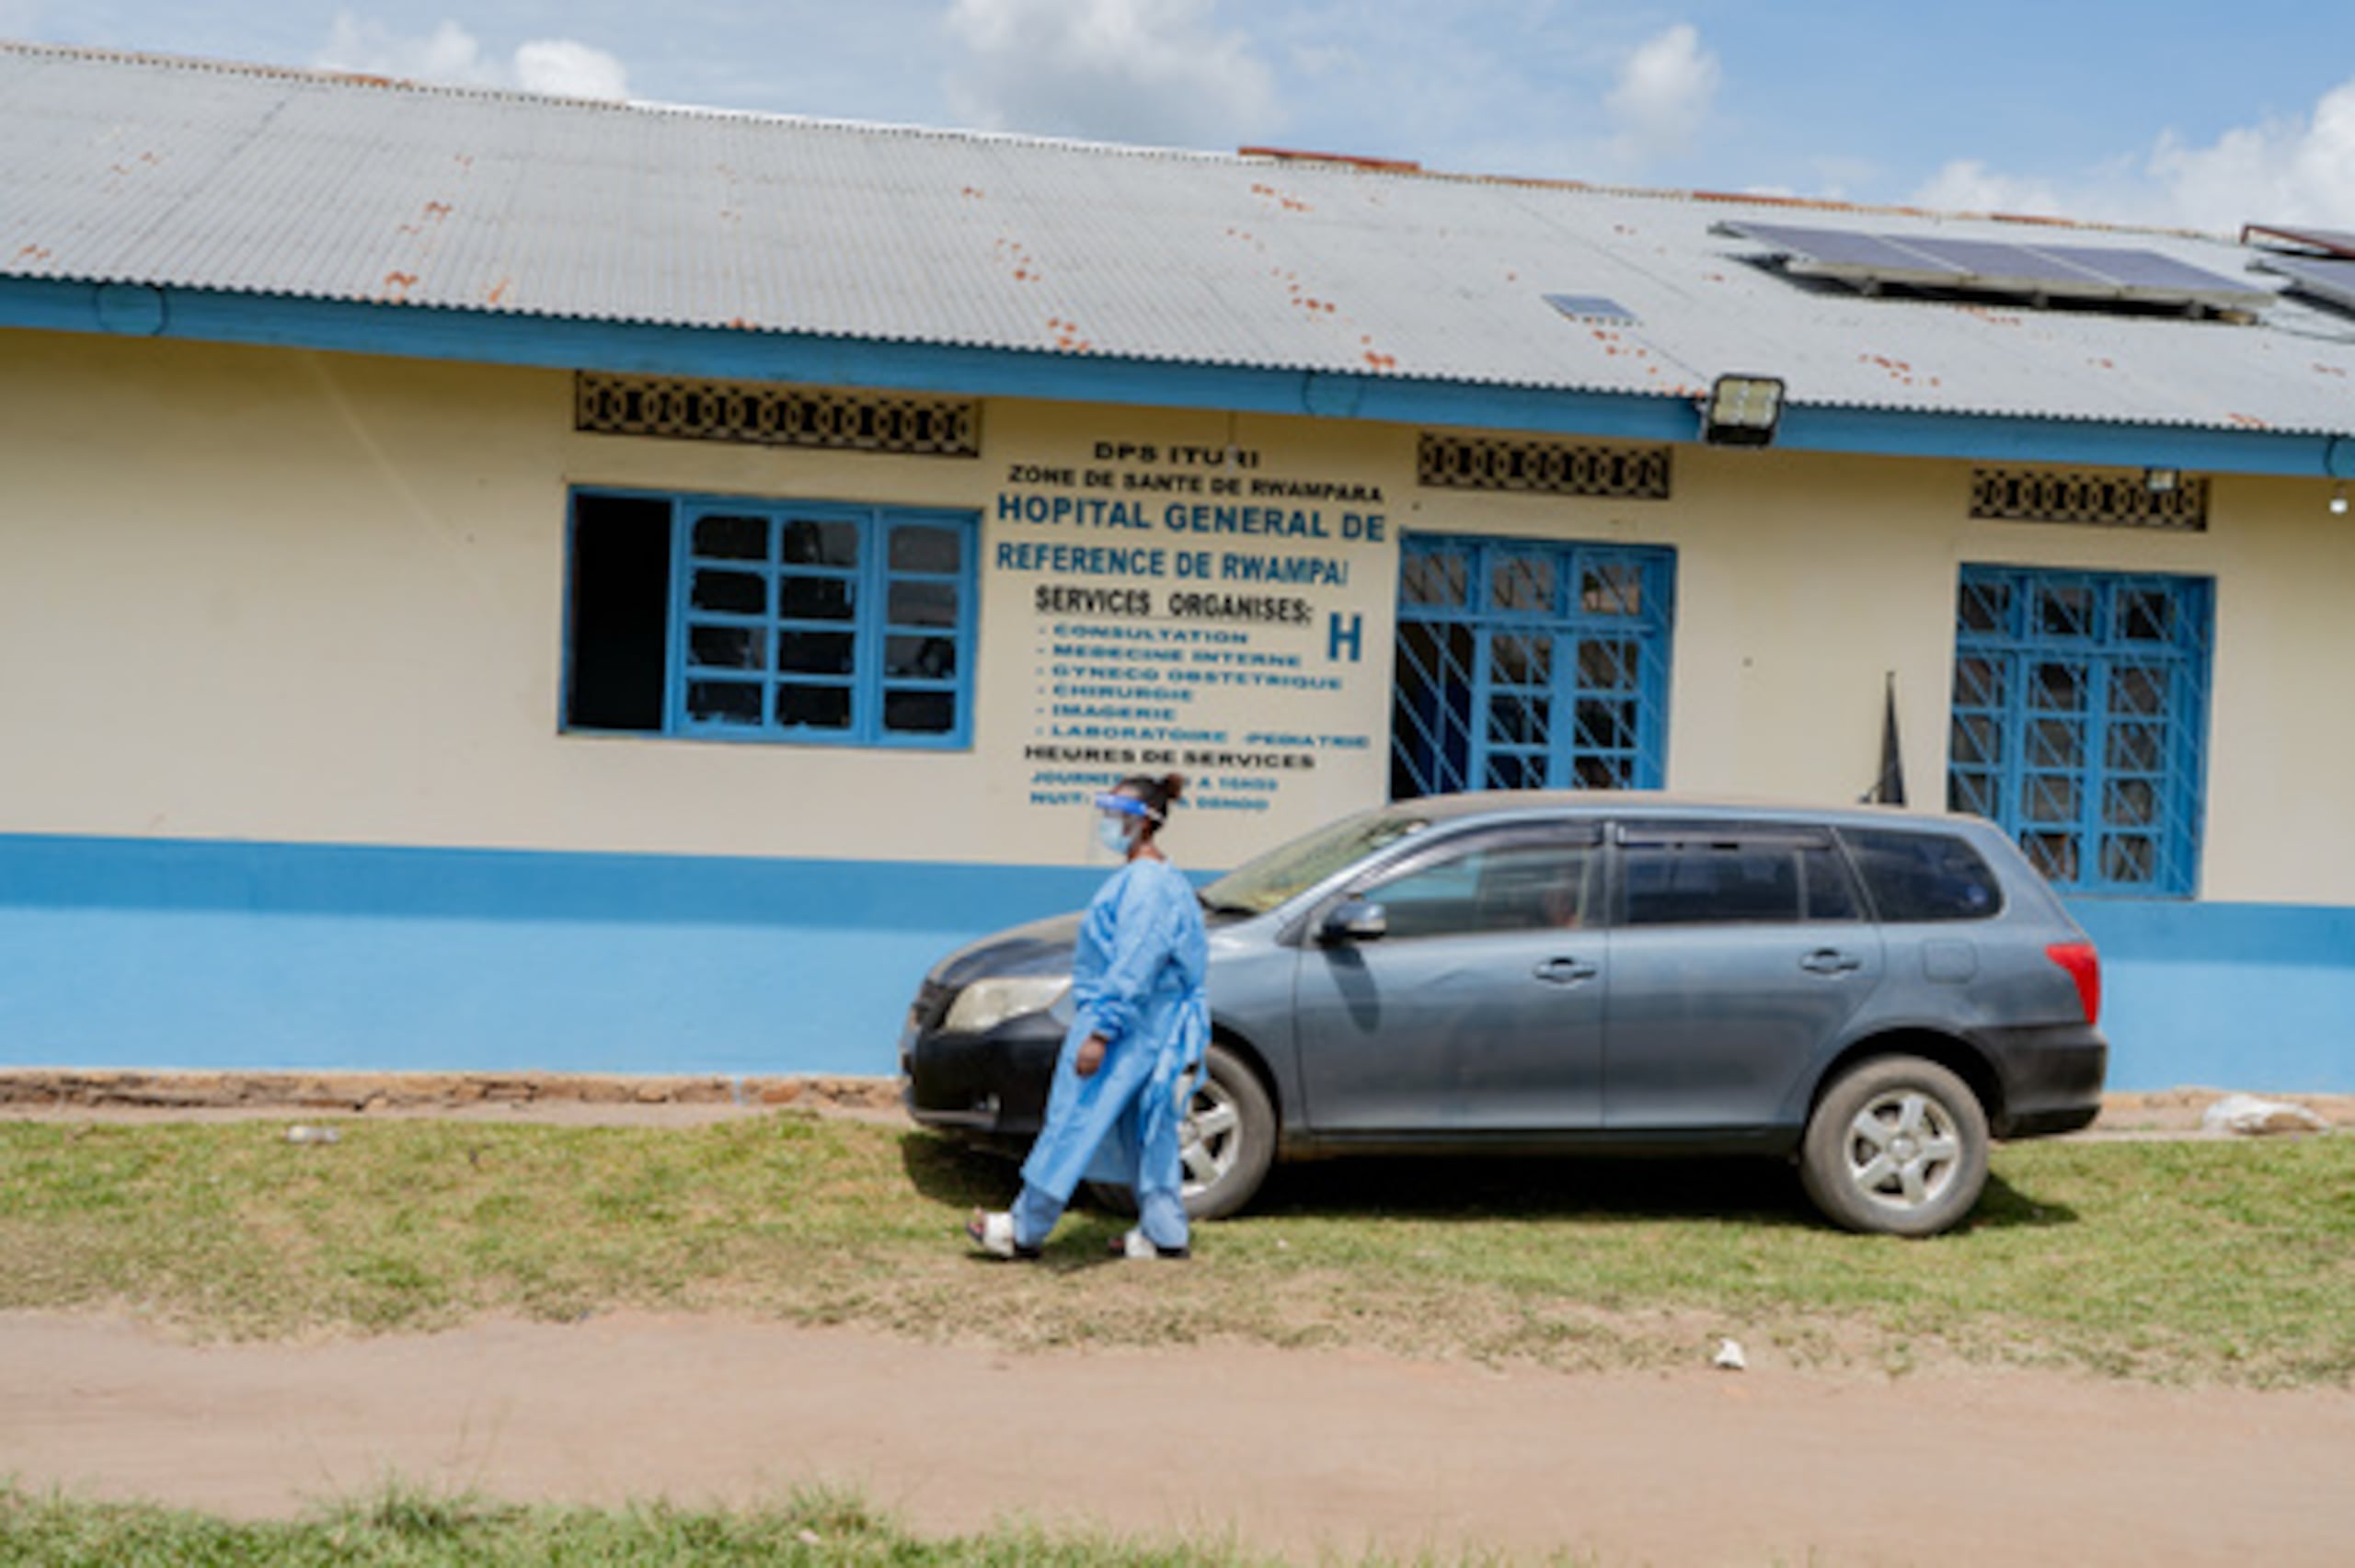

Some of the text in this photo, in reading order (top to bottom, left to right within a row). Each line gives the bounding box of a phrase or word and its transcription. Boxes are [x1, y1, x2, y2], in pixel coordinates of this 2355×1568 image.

[1095, 441, 1157, 463] DPS
[1008, 464, 1384, 502] ZONE DE SANTE DE RWAMPARA
[998, 492, 1385, 542] HOPITAL GENERAL DE
[996, 543, 1165, 576] REFERENCE
[1176, 551, 1211, 579] DE
[1036, 585, 1151, 615] SERVICES
[1052, 624, 1247, 644] CONSULTATION
[1327, 612, 1361, 662] H
[1052, 644, 1183, 663] MEDECINE
[1191, 650, 1302, 667] INTERNE
[1051, 665, 1159, 681] GYNECO
[1167, 670, 1342, 691] OBSTETRIQUE
[1052, 684, 1192, 704] CHIRURGIE
[1052, 704, 1176, 721] IMAGERIE
[1051, 725, 1227, 744] LABORATOIRE
[1025, 745, 1315, 770] HEURES DE SERVICES
